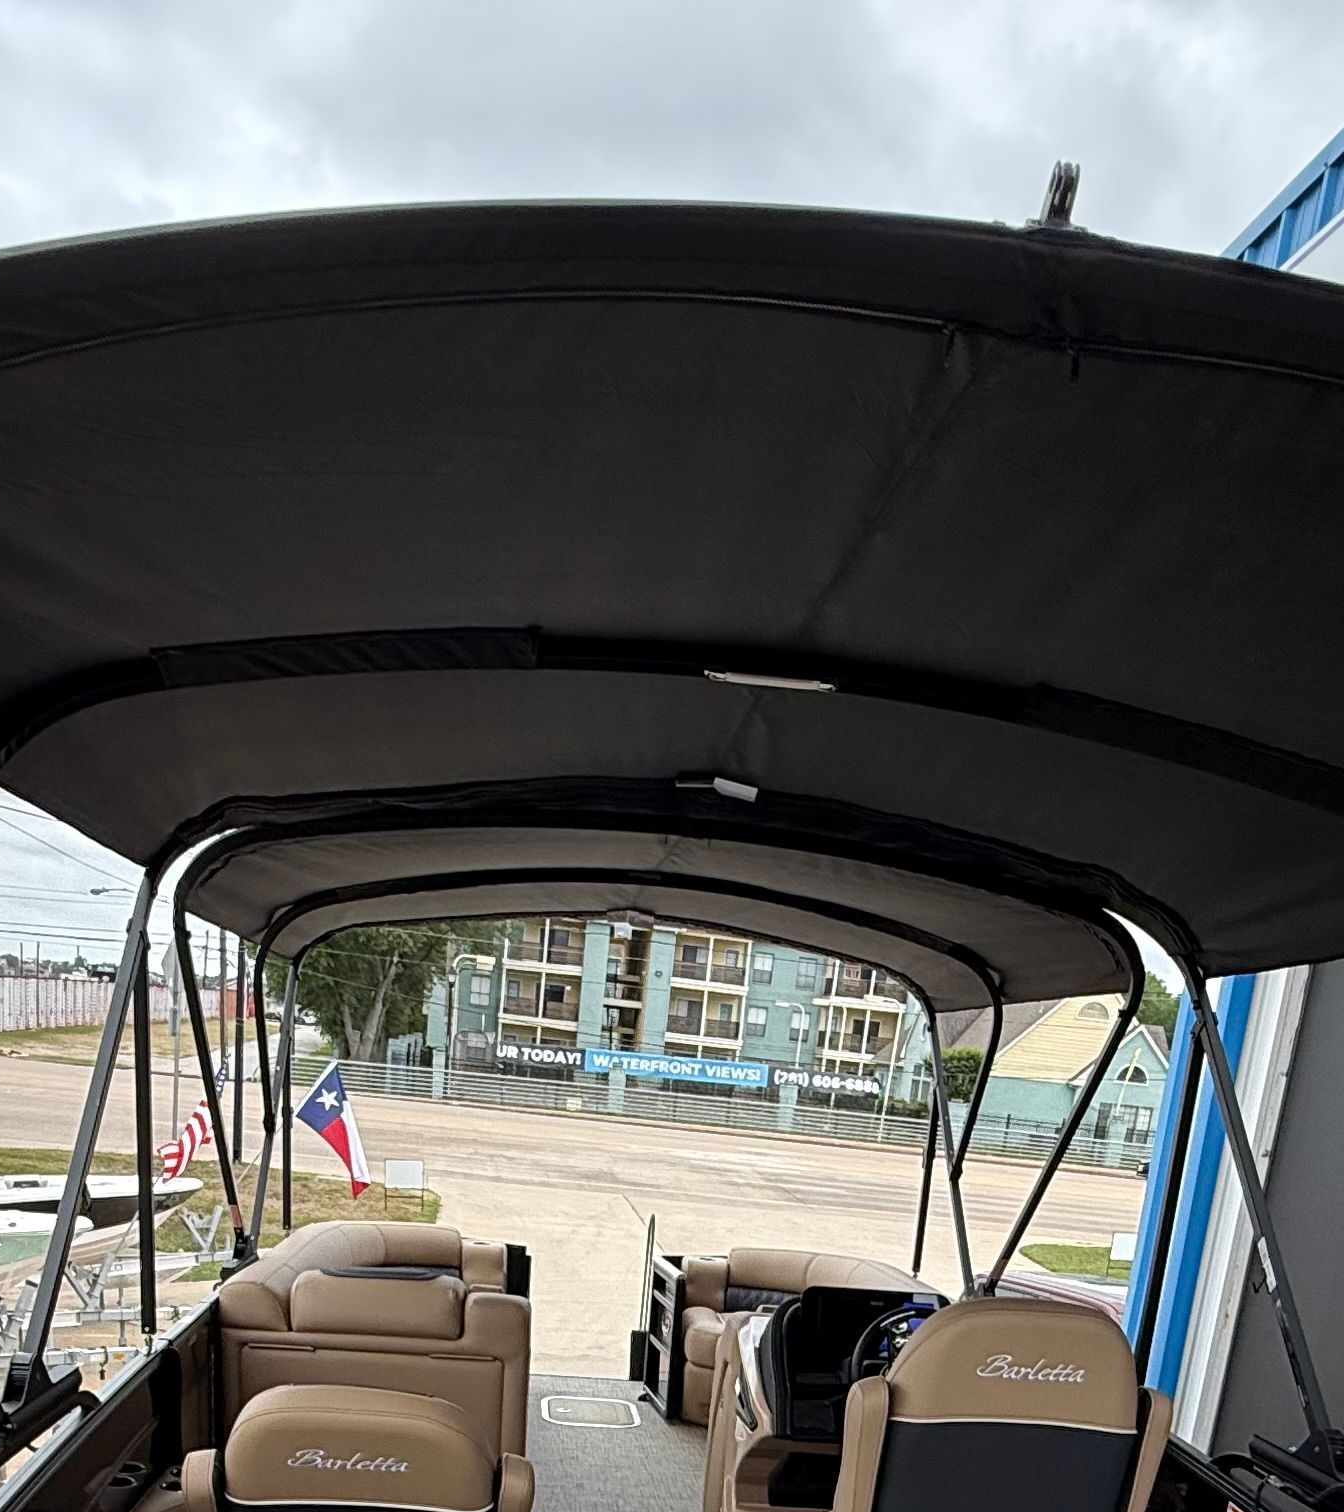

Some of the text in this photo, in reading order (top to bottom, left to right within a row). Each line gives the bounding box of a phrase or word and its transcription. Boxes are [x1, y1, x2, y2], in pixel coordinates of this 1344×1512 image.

[521, 1047, 582, 1065] TODAY!
[593, 1054, 761, 1082] WATERFRONT VIEWS!
[976, 1353, 1086, 1383] Barletta
[287, 1448, 410, 1473] Barletta
